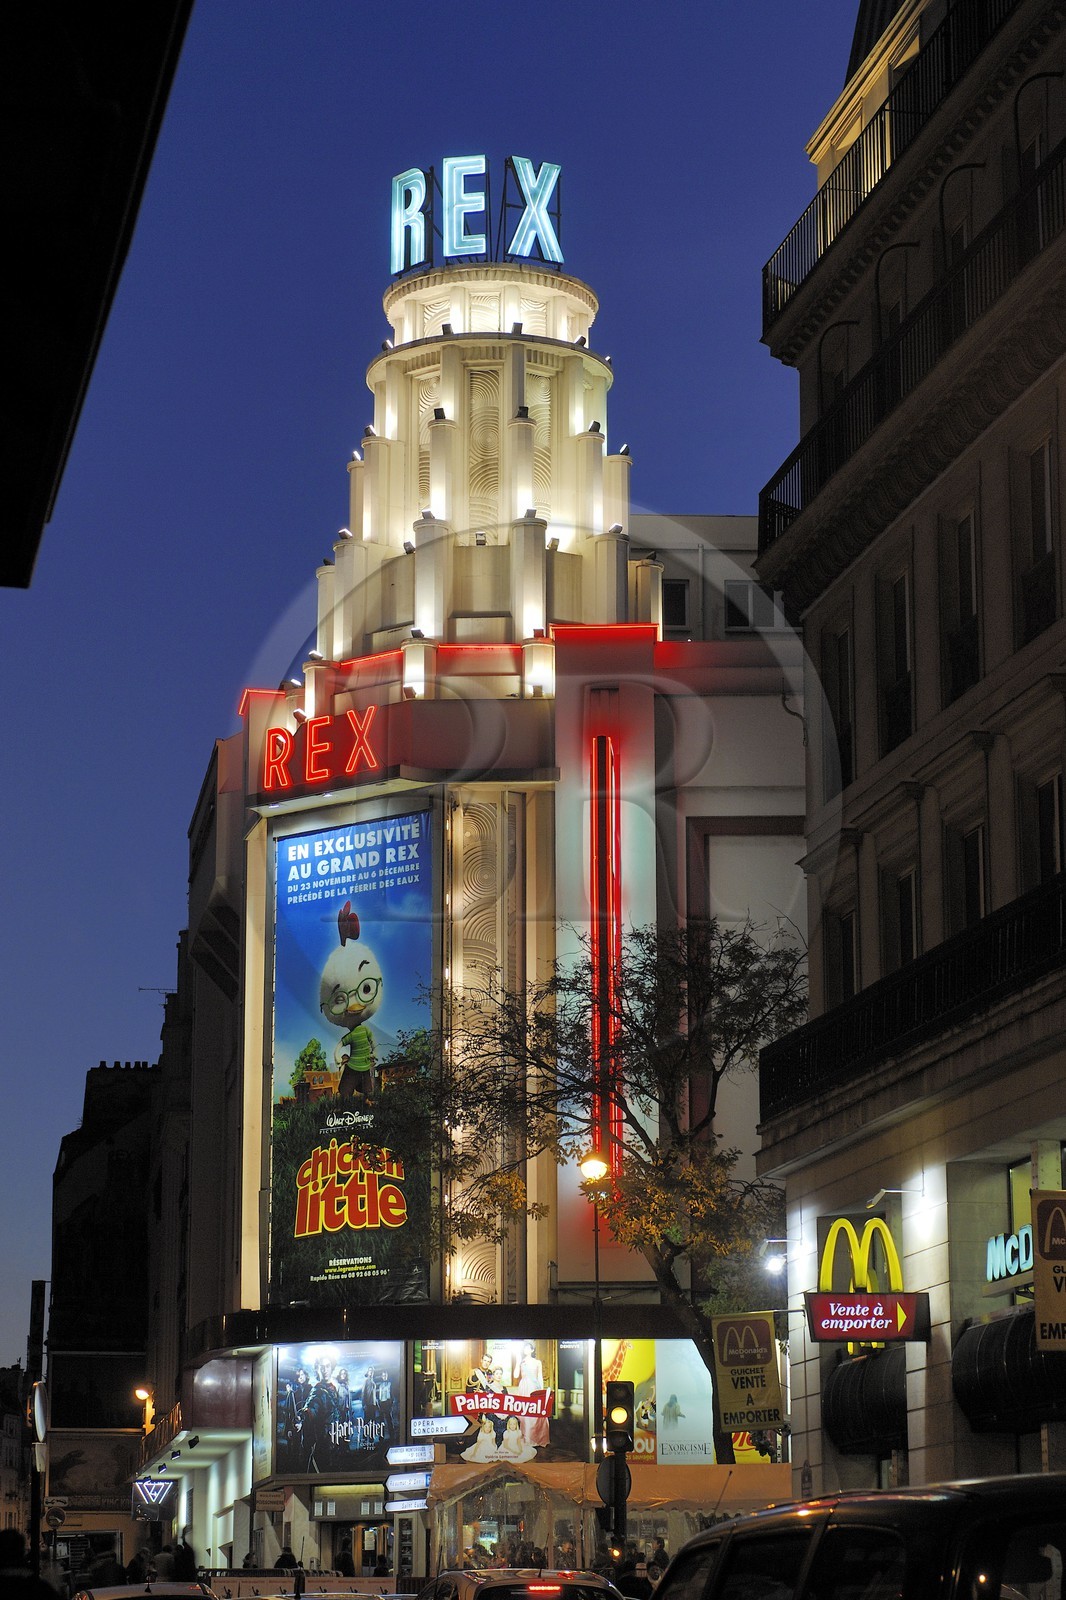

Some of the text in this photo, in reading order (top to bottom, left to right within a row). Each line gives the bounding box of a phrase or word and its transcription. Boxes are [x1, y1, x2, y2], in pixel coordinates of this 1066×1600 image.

[390, 154, 564, 275] REX
[262, 703, 379, 791] REX
[288, 819, 420, 862] EN EXCLUSIVITÉ
[287, 843, 420, 882] AU GRAND REX
[287, 863, 420, 893] DU 23 NOVEMBRE AU 6 DÉCEMBRE
[287, 874, 420, 905] PRÉCÉDÉ DE LA FÉERIE DES EAUX
[295, 1173, 408, 1238] little
[324, 1264, 377, 1274] www.legrandrex.com
[328, 1256, 372, 1267] RÉSERVATIONS
[829, 1302, 884, 1316] Vente à
[821, 1317, 893, 1333] emporter
[728, 1347, 768, 1356] McDonald's
[730, 1367, 764, 1376] GUICHET
[731, 1374, 766, 1389] VENTE
[455, 1386, 552, 1415] Palais Royal!
[746, 1394, 755, 1405] A
[723, 1409, 781, 1425] EMPORTER
[356, 1418, 386, 1446] Potter
[413, 1427, 448, 1435] CONCORDE
